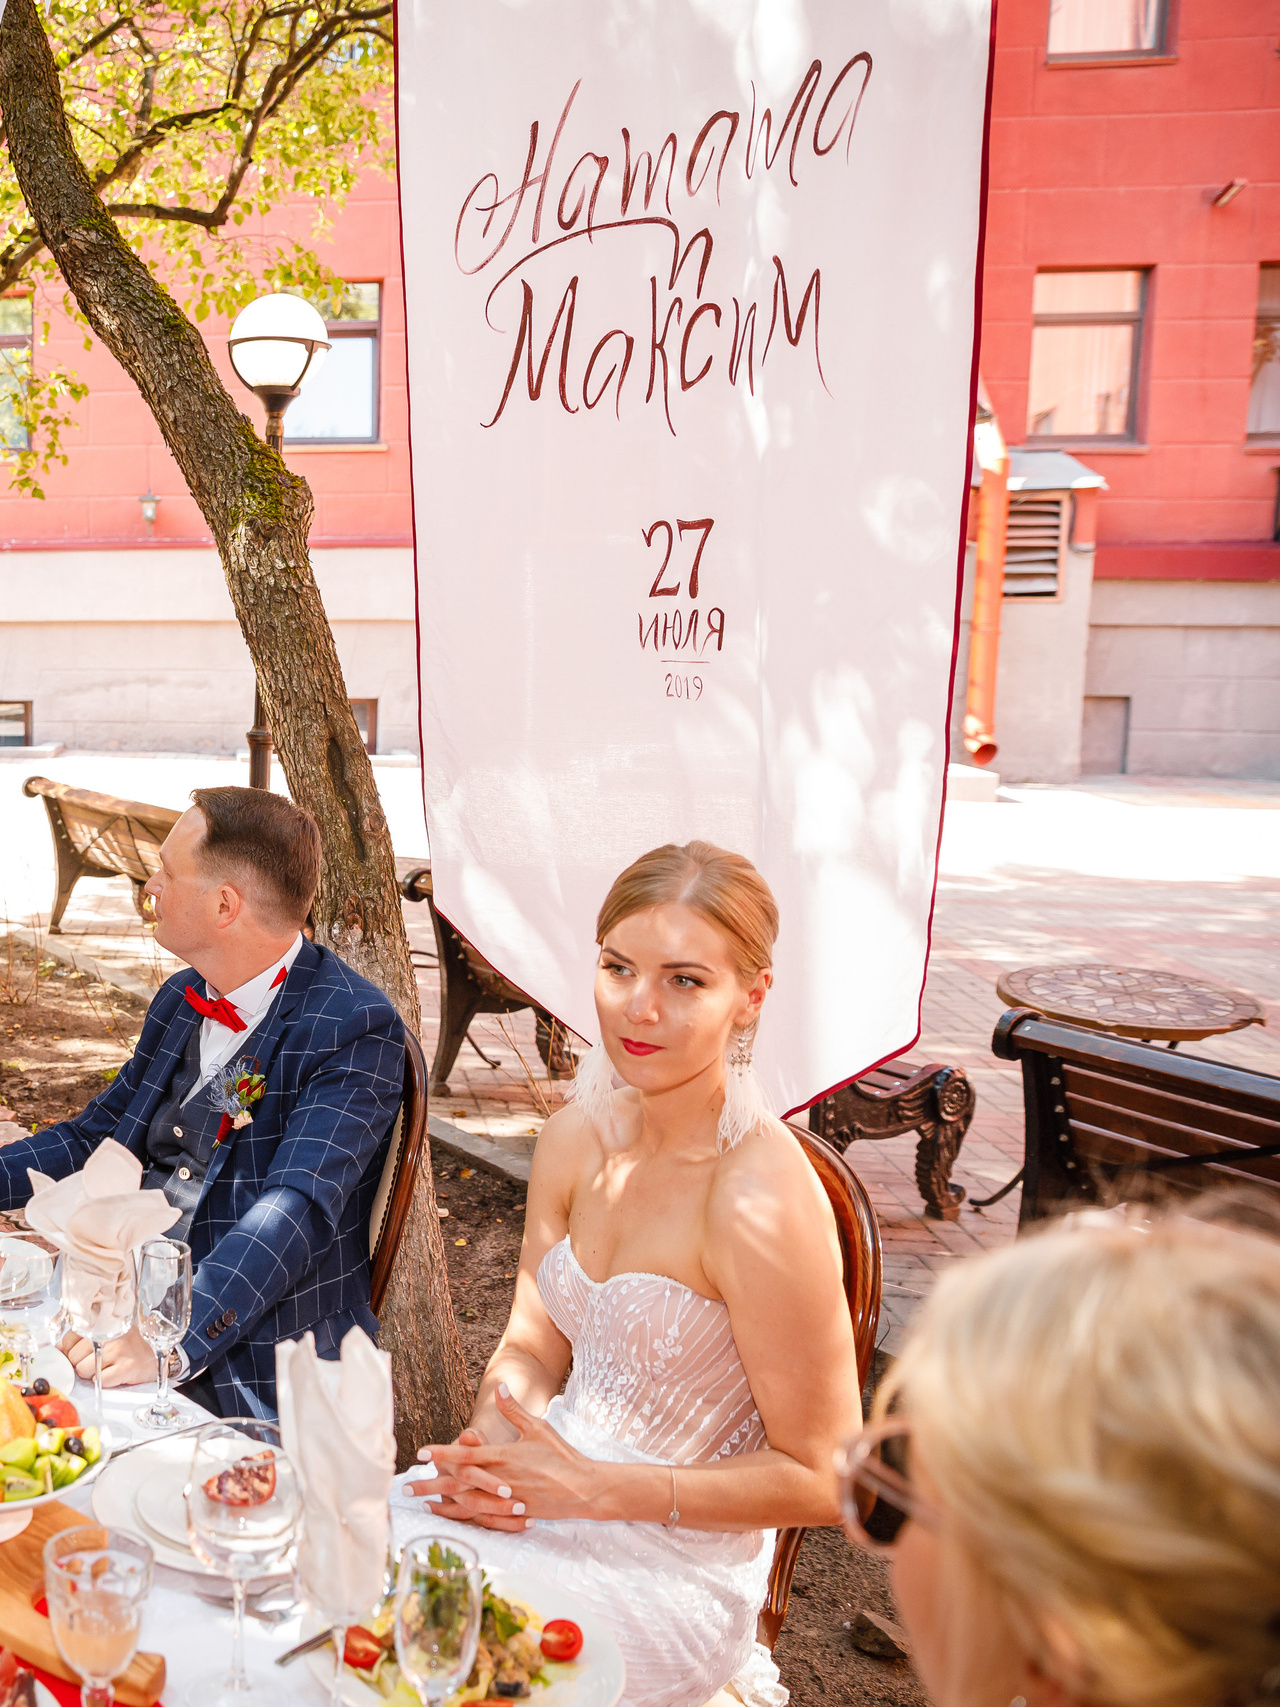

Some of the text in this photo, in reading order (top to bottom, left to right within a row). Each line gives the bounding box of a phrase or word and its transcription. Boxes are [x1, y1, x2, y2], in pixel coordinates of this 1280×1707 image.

[455, 51, 873, 275] Наташа
[480, 255, 835, 436] Максим
[641, 518, 714, 600] 27
[665, 673, 703, 701] 2019
